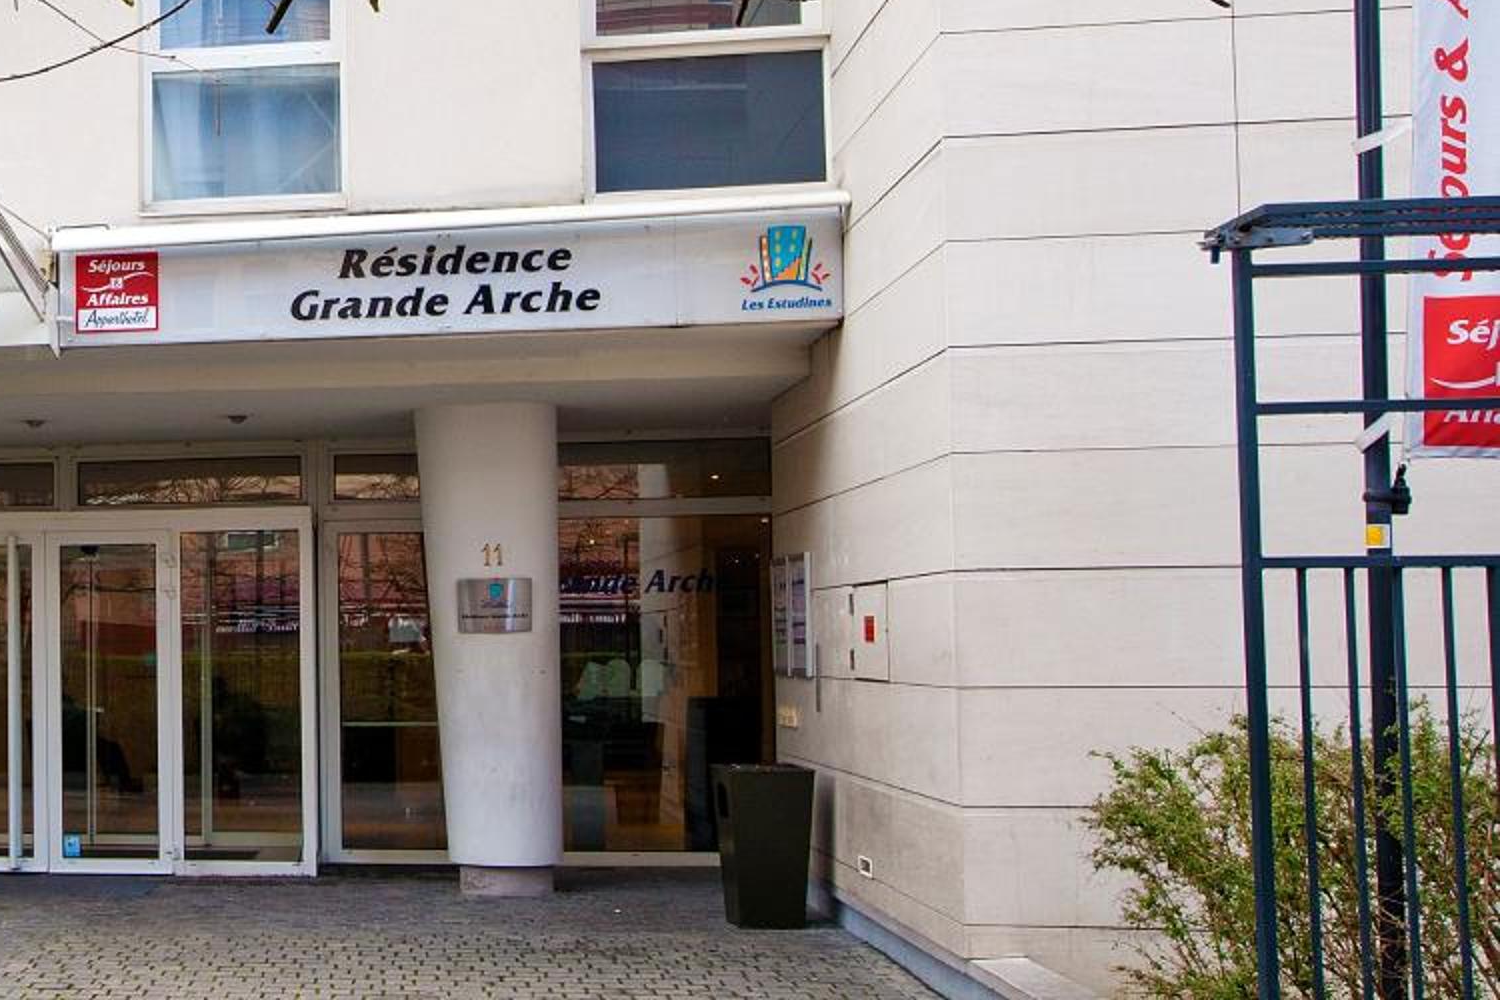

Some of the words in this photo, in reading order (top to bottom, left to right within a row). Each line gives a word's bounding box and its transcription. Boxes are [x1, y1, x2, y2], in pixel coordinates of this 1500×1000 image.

[1434, 36, 1468, 83] &
[88, 259, 146, 275] Séjours
[337, 245, 573, 280] Résidence
[86, 292, 149, 307] Affaires
[290, 287, 450, 321] Grande
[463, 281, 601, 315] Arche
[741, 299, 764, 311] Les
[767, 296, 833, 310] Estudines
[481, 543, 502, 567] 11
